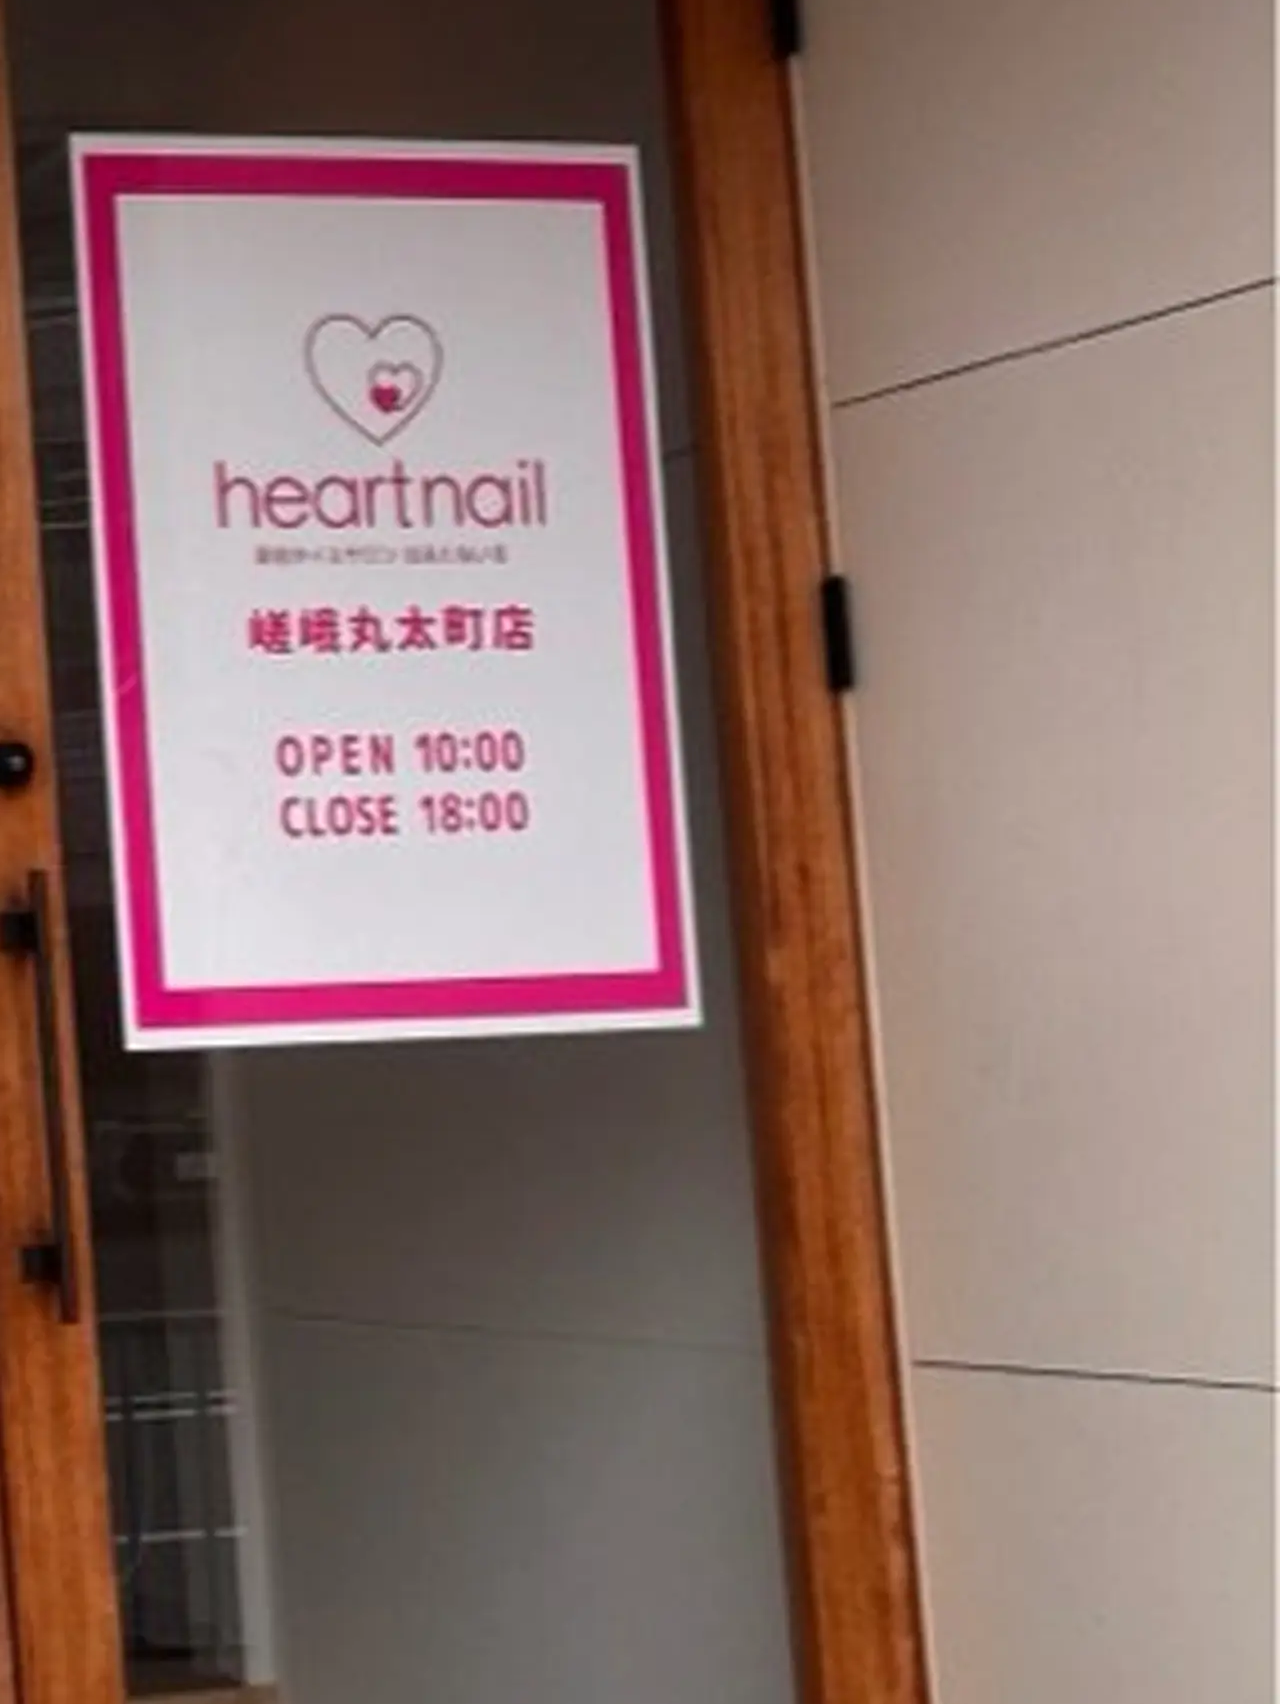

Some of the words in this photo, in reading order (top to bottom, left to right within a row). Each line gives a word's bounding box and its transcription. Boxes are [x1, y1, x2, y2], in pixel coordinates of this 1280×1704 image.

[247, 604, 535, 655] 嵯峨丸太町店
[275, 733, 395, 778] OPEN
[413, 729, 526, 773] 10:00
[279, 795, 399, 838] CLOSE
[419, 791, 530, 835] 18:00
